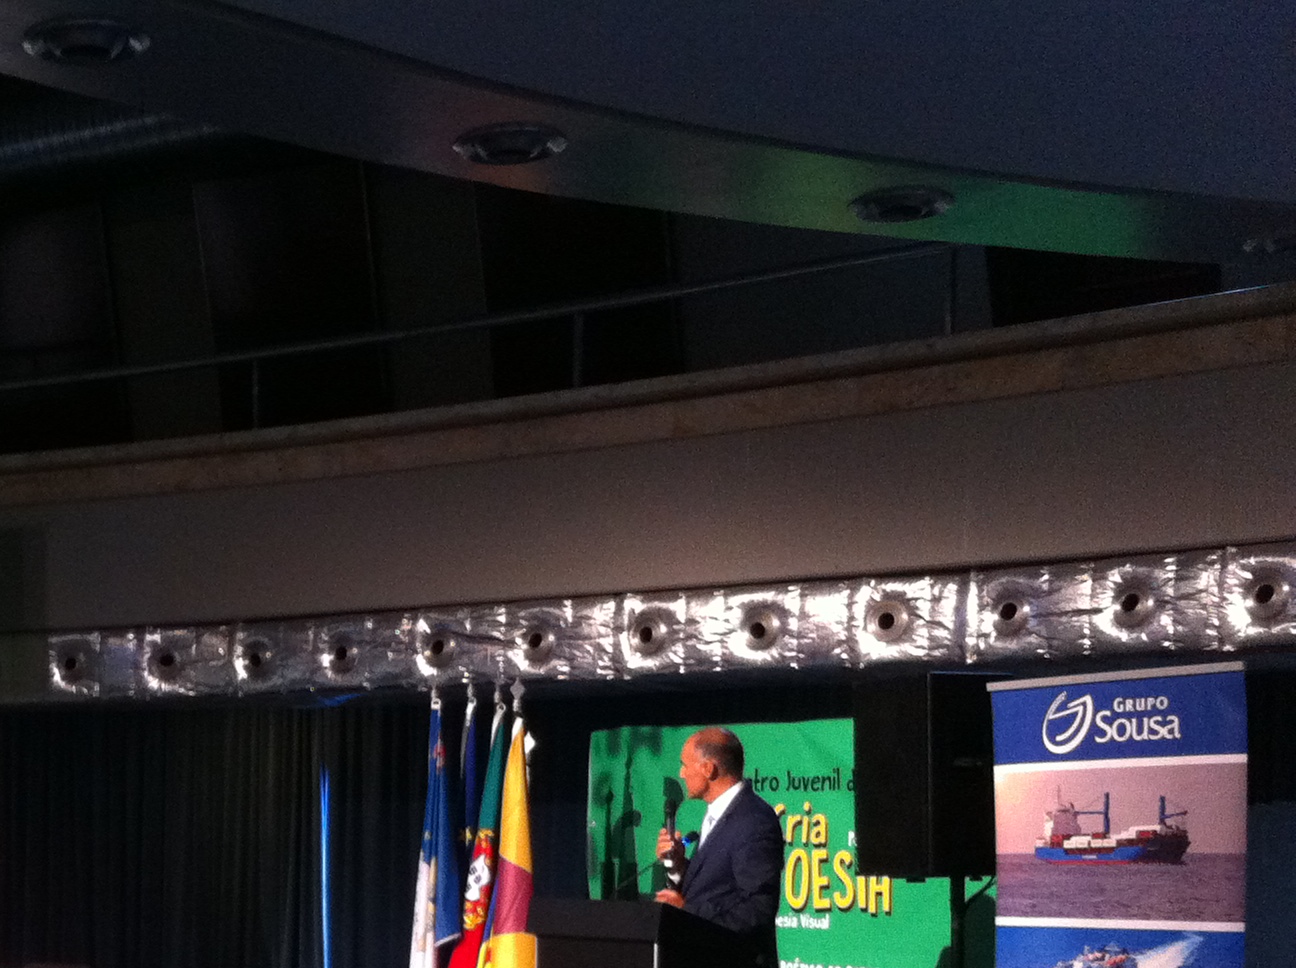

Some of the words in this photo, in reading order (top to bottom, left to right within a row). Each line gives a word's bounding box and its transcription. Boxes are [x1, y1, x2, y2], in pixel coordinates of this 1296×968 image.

[1113, 696, 1169, 713] GRUPO
[1094, 710, 1181, 743] Sousa
[750, 768, 780, 792] tro
[785, 767, 841, 793] Juvenil
[799, 913, 831, 930] Visual
